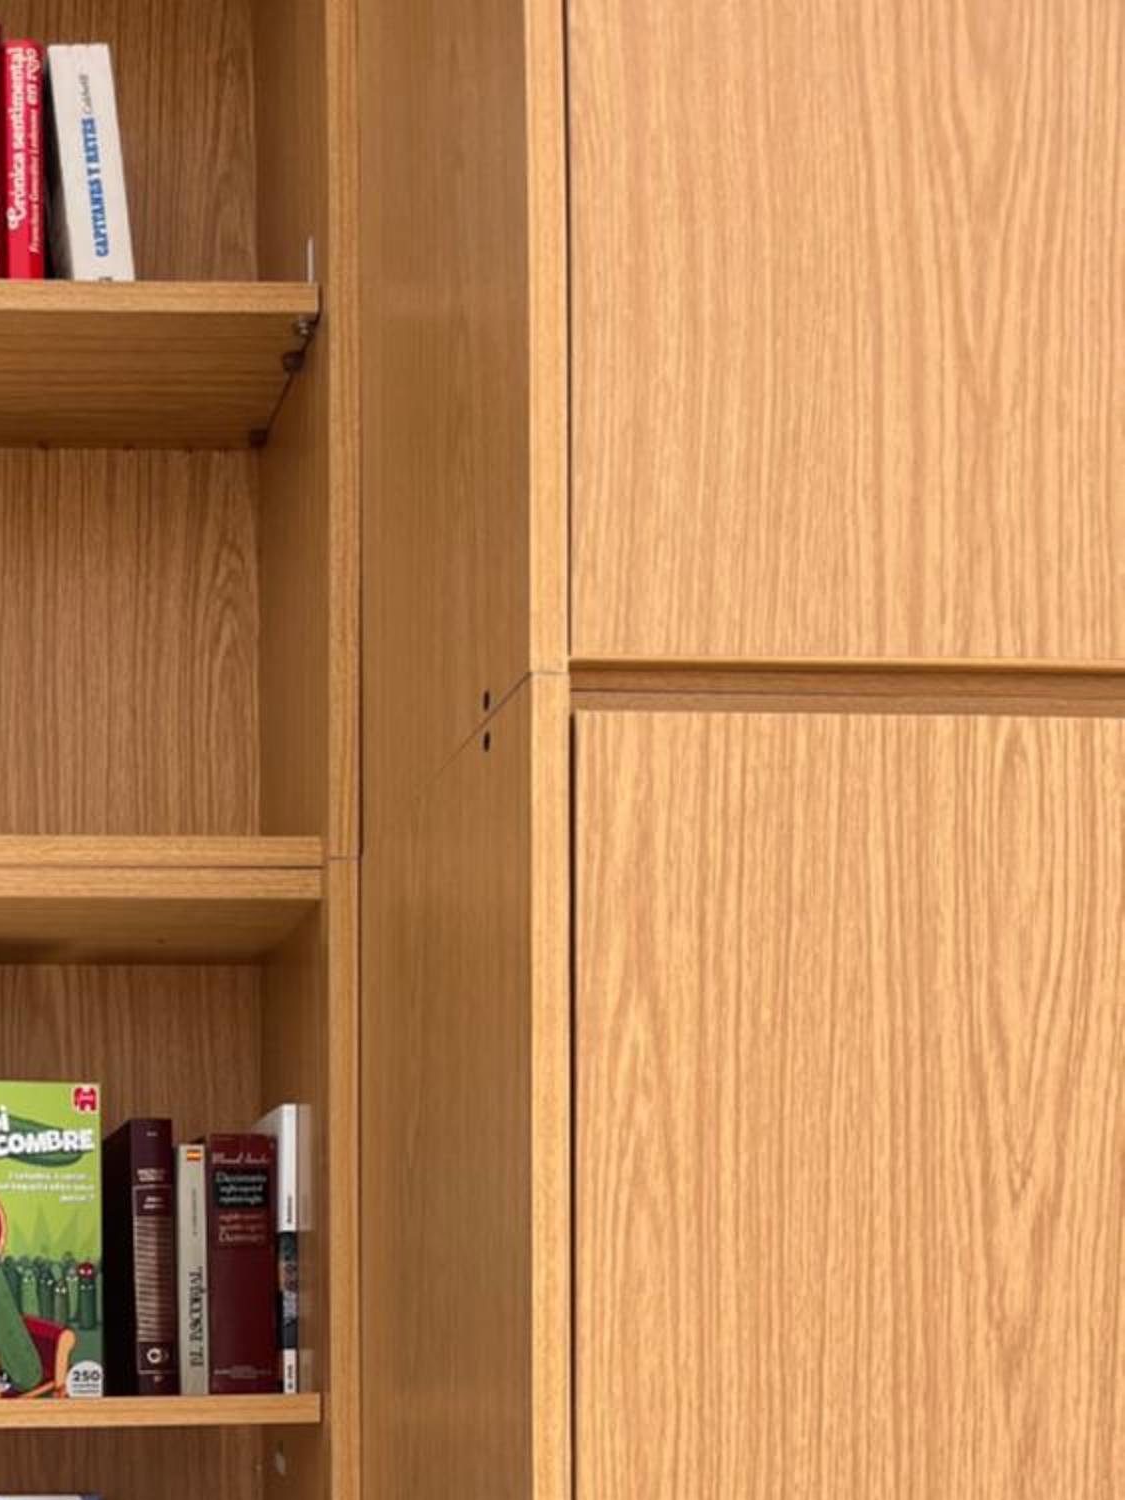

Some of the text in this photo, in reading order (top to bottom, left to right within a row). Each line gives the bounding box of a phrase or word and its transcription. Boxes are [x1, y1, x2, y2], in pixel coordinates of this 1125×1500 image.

[25, 47, 41, 106] en rojo
[6, 47, 28, 231] Crónica sentimental
[81, 117, 109, 258] CAPITANES Y REYES
[71, 1369, 101, 1383] 250
